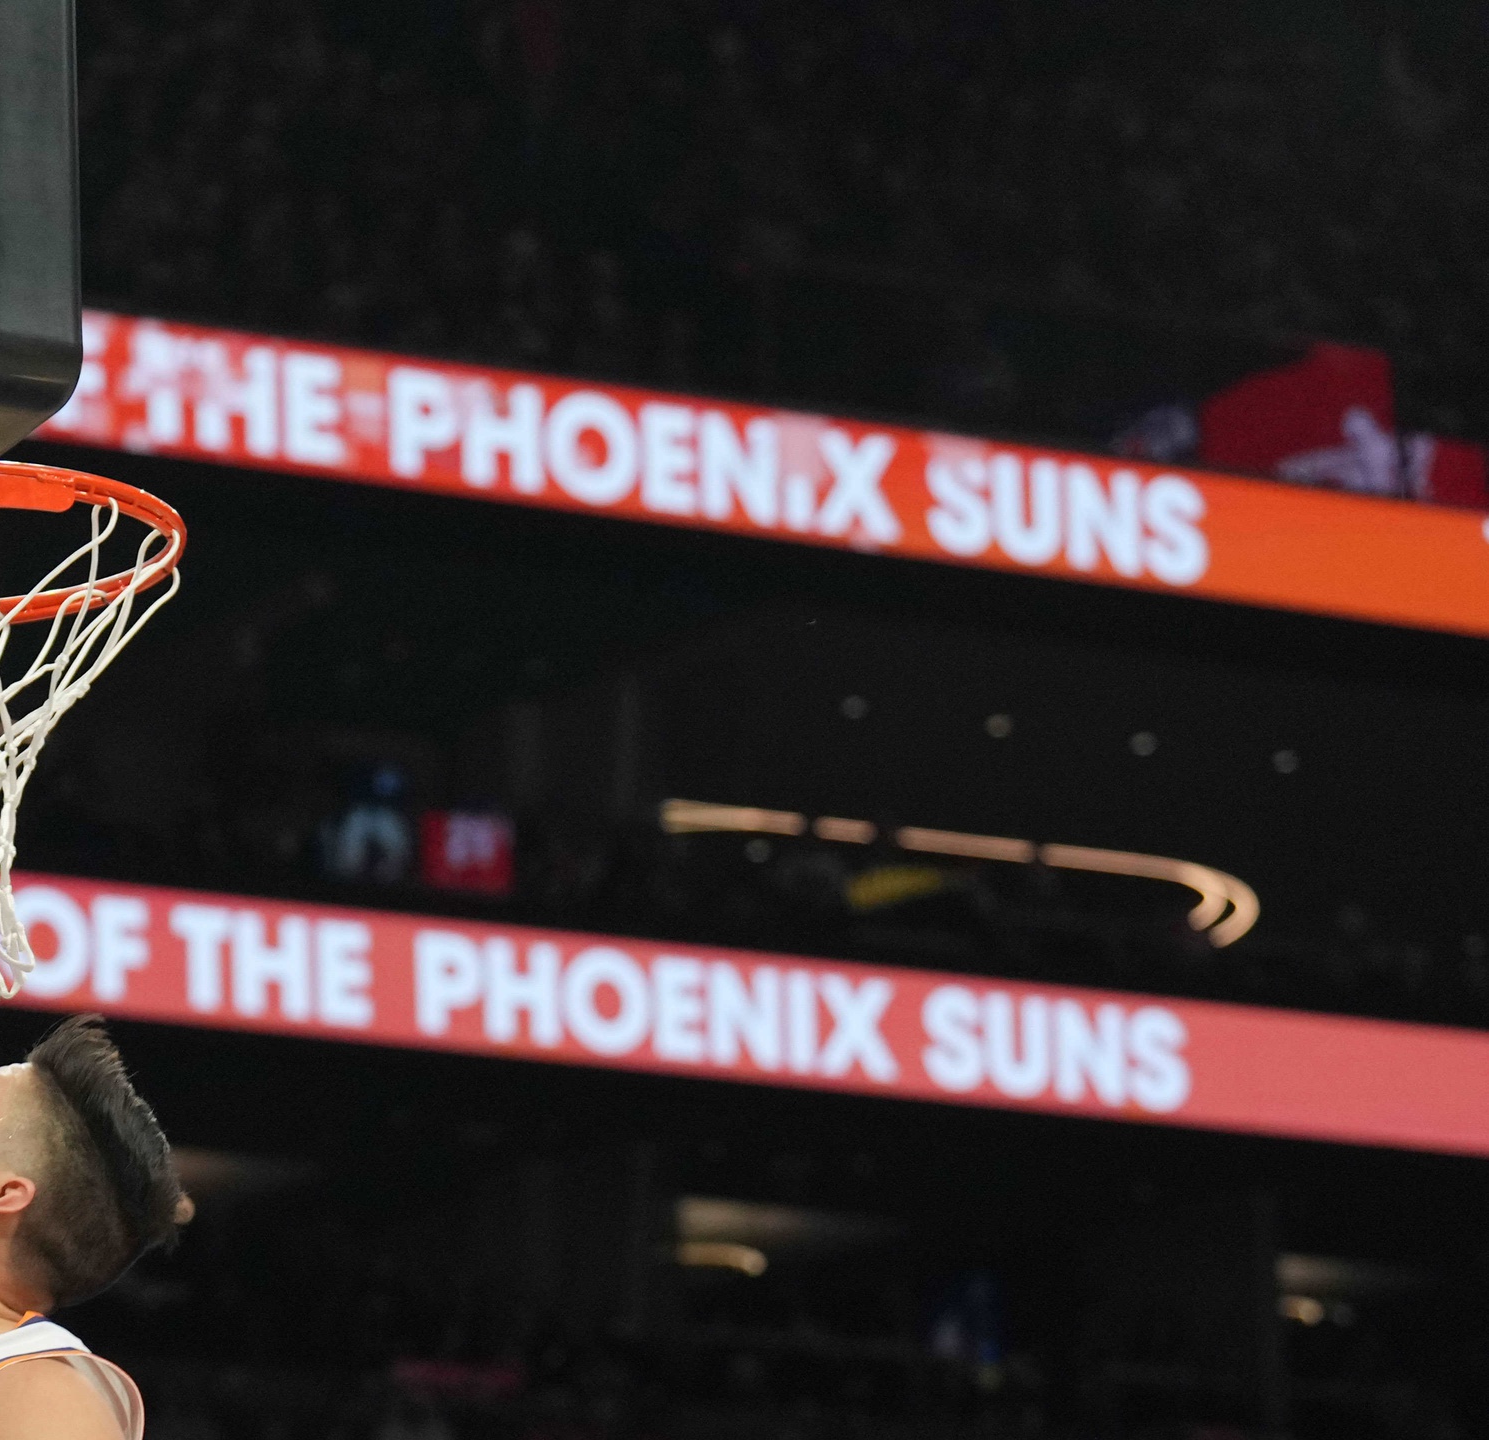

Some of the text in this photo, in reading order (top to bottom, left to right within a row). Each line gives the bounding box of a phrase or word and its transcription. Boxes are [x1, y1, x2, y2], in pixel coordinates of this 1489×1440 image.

[128, 322, 348, 467] THE
[388, 367, 903, 545] PHOENIX
[926, 448, 1209, 586] SUNS
[8, 886, 150, 1001] OF
[170, 906, 374, 1028] THE
[413, 930, 901, 1086] PHOENIX
[923, 986, 1193, 1114] SUNS
